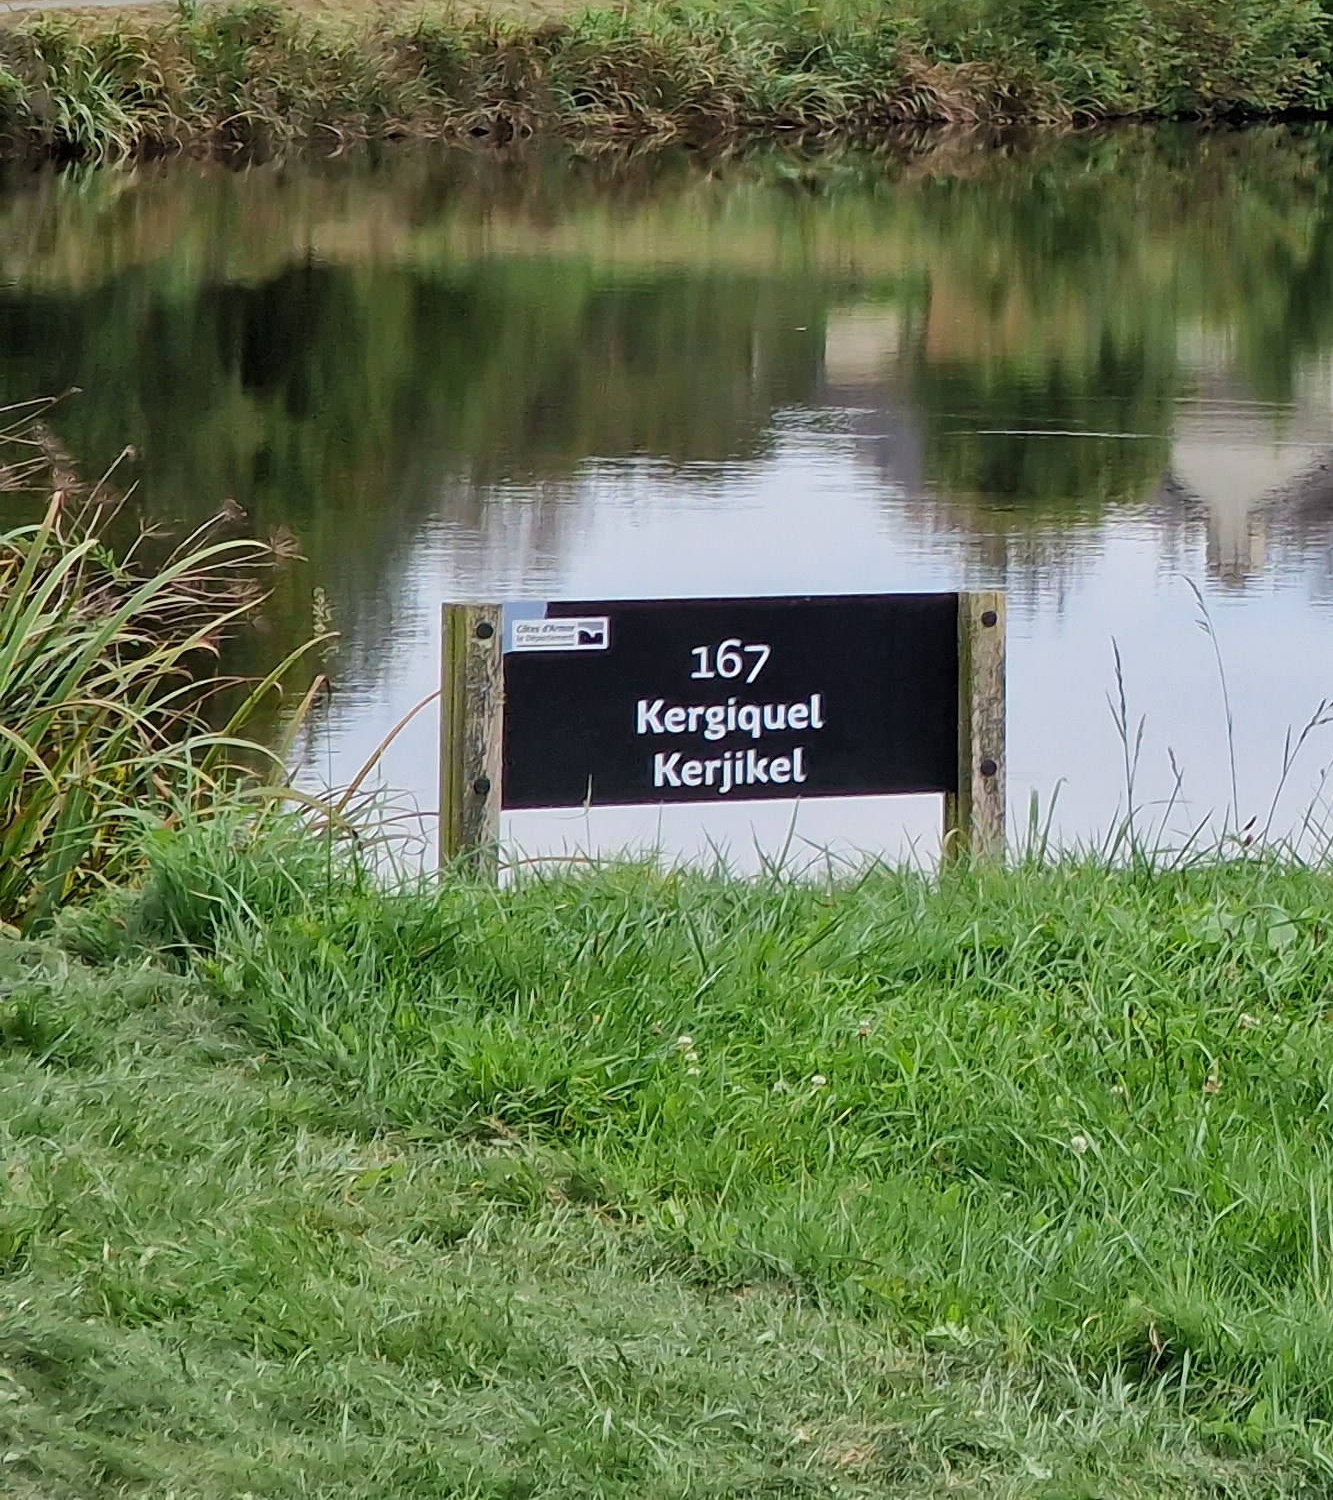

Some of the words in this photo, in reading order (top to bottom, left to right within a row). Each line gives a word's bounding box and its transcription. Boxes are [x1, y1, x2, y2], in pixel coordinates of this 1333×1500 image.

[690, 638, 771, 684] 167
[636, 693, 824, 741] Kergiquel
[654, 746, 807, 794] Kerjikel
